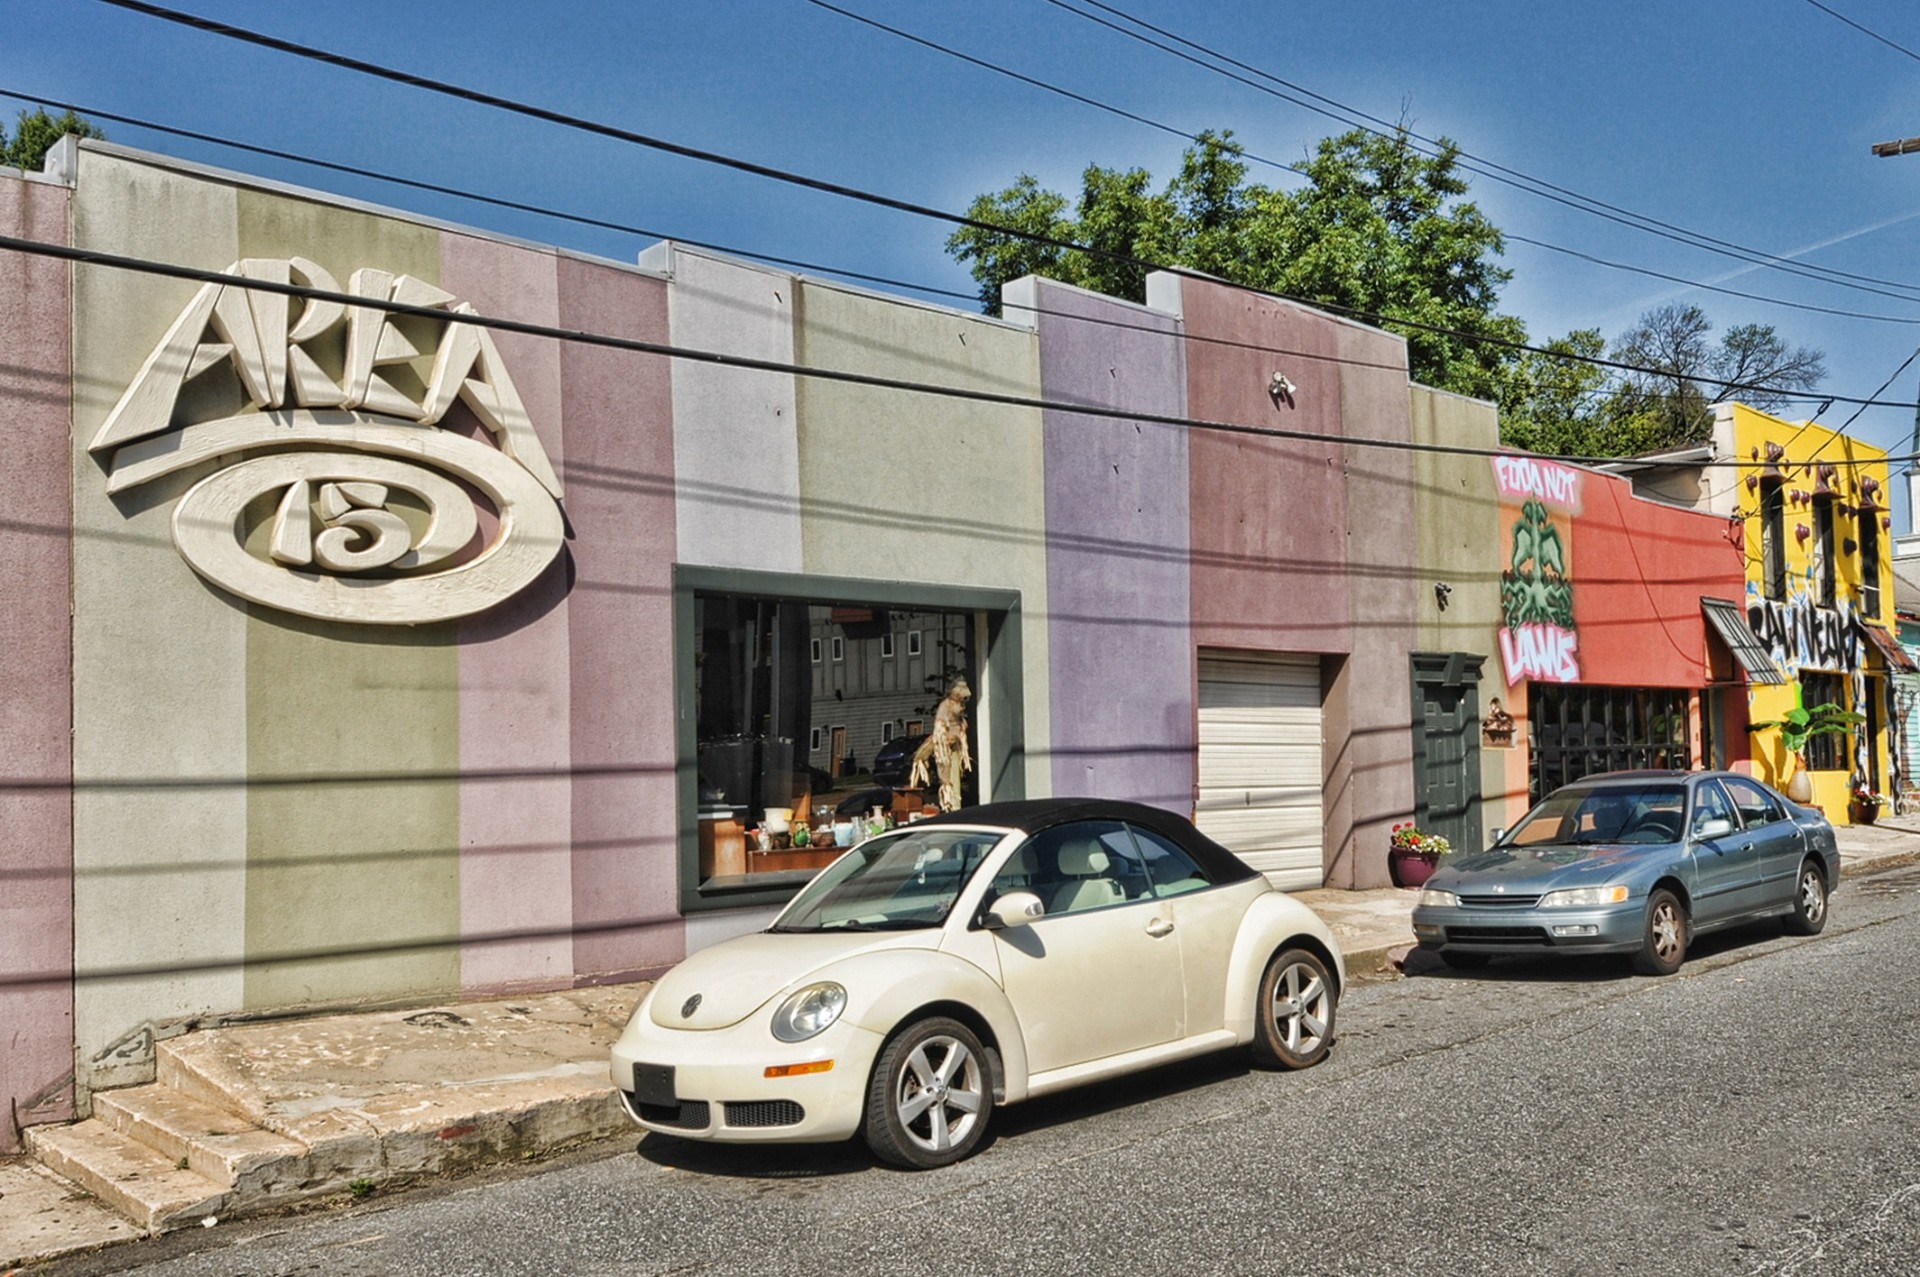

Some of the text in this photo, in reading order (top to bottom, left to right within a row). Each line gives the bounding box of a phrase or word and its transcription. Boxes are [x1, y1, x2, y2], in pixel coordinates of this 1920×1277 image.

[87, 256, 564, 500] AREA
[269, 478, 412, 572] 15
[1495, 456, 1577, 504] FOOD NOT
